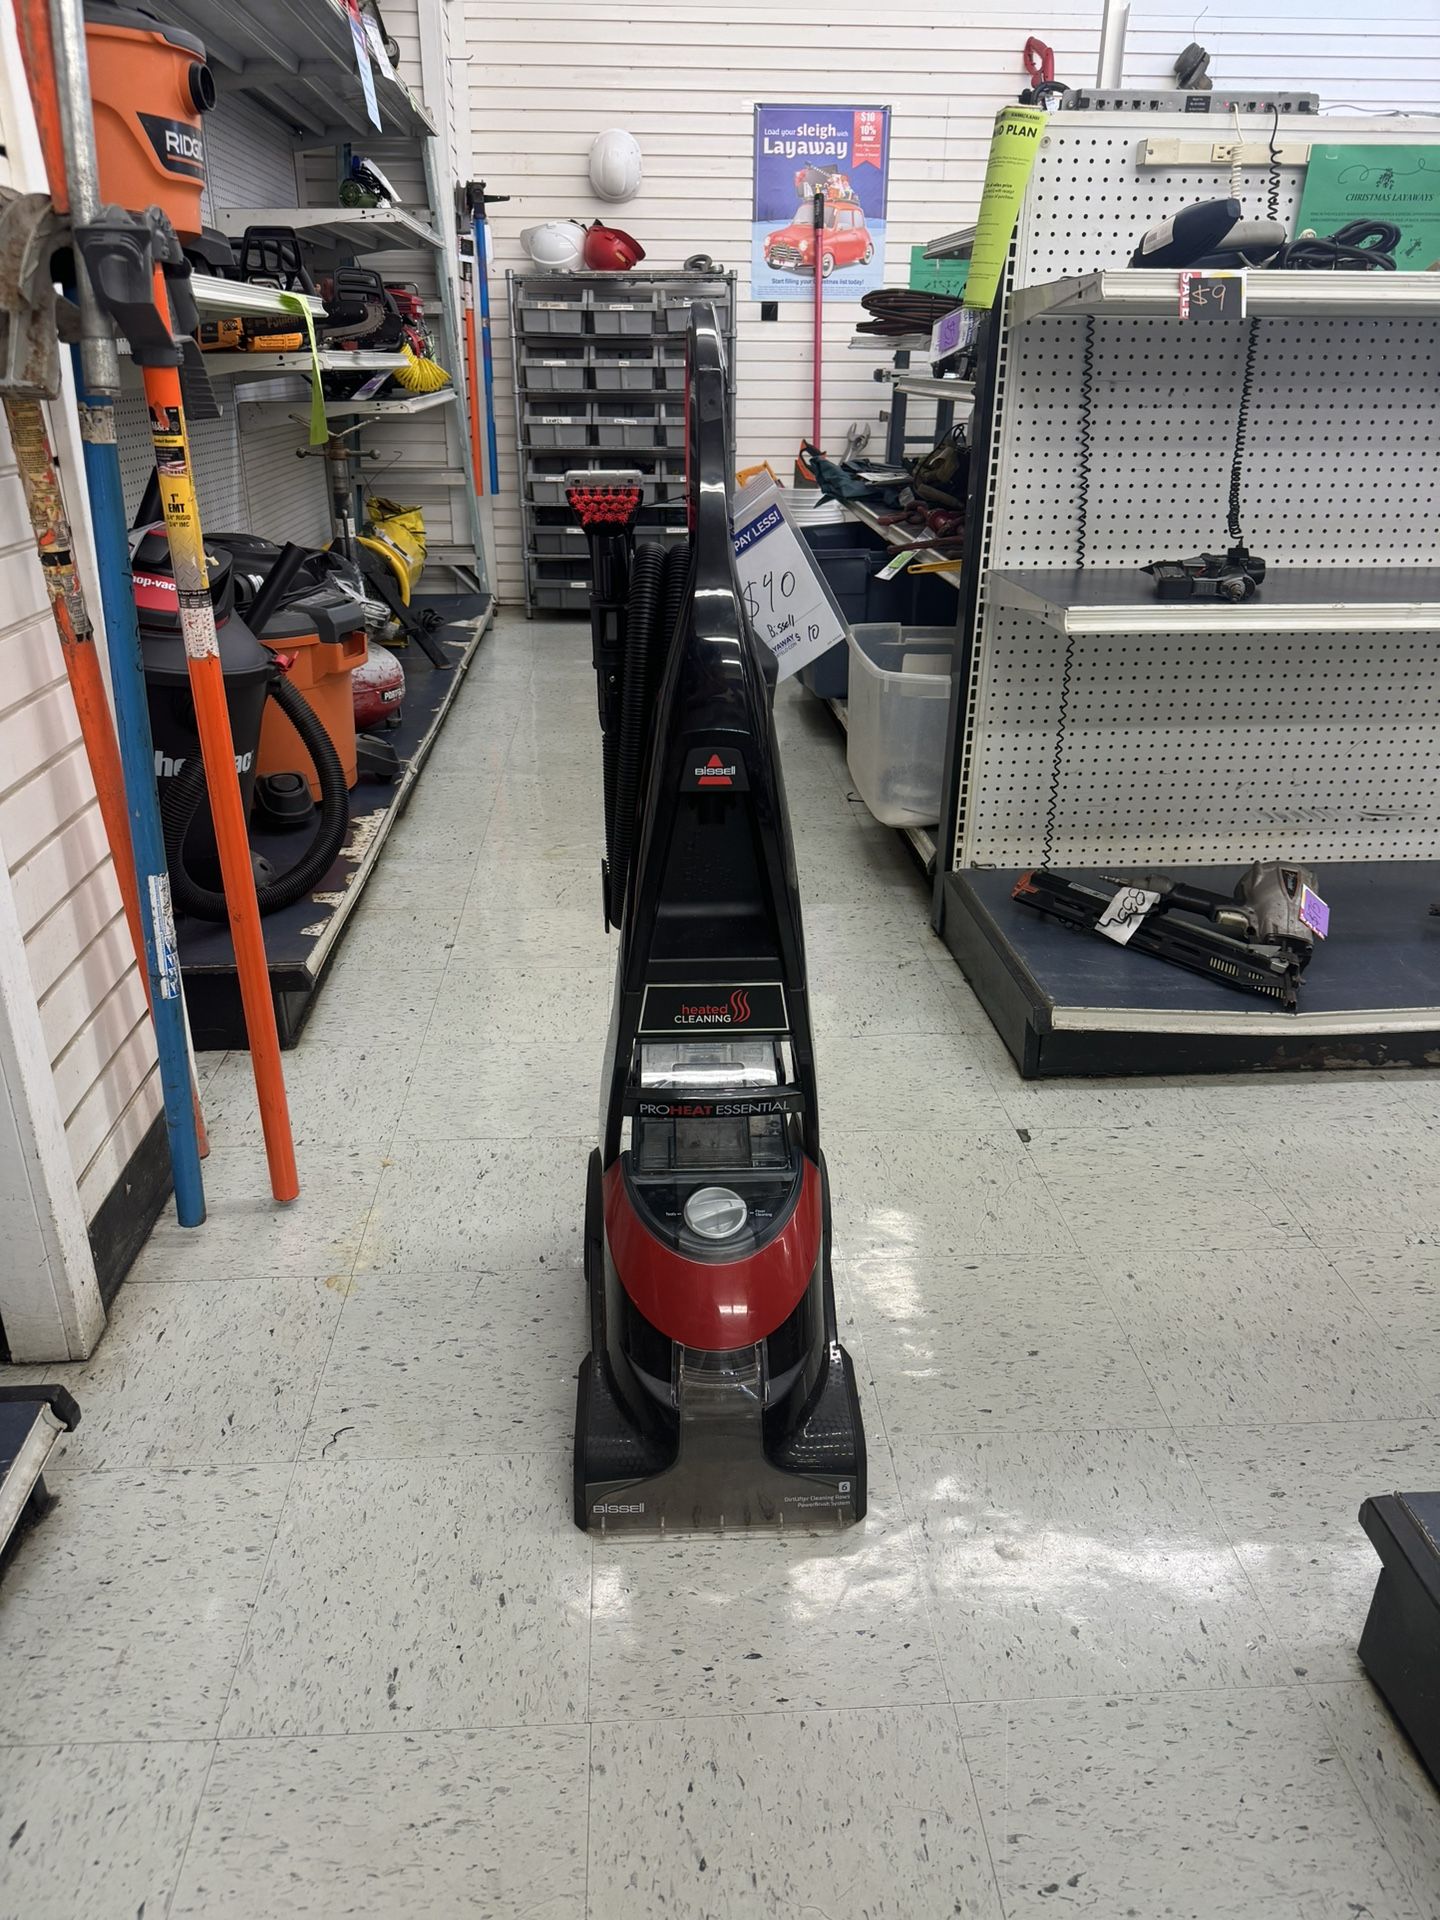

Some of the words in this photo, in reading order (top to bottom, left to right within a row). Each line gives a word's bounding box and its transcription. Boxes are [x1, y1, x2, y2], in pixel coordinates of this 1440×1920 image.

[764, 128, 780, 136] Load
[780, 130, 796, 138] your
[796, 123, 837, 139] sleigh
[860, 125, 876, 136] 10%
[1006, 124, 1038, 138] PLAN
[764, 137, 848, 159] Layaway
[1346, 193, 1392, 202] CHRISTMAS
[1392, 193, 1434, 202] LAYAWAYS
[1182, 272, 1192, 319] SALE
[1192, 284, 1226, 312] $9
[168, 503, 185, 513] EMT
[734, 532, 752, 551] PAY
[752, 510, 780, 537] LESS!
[742, 571, 796, 627] $40
[795, 634, 802, 642] $
[808, 624, 820, 642] 10
[682, 1004, 728, 1015] heated
[674, 1014, 732, 1024] CLEANING
[640, 1104, 714, 1116] PROHEAT
[716, 1101, 790, 1115] ESSENTIAL
